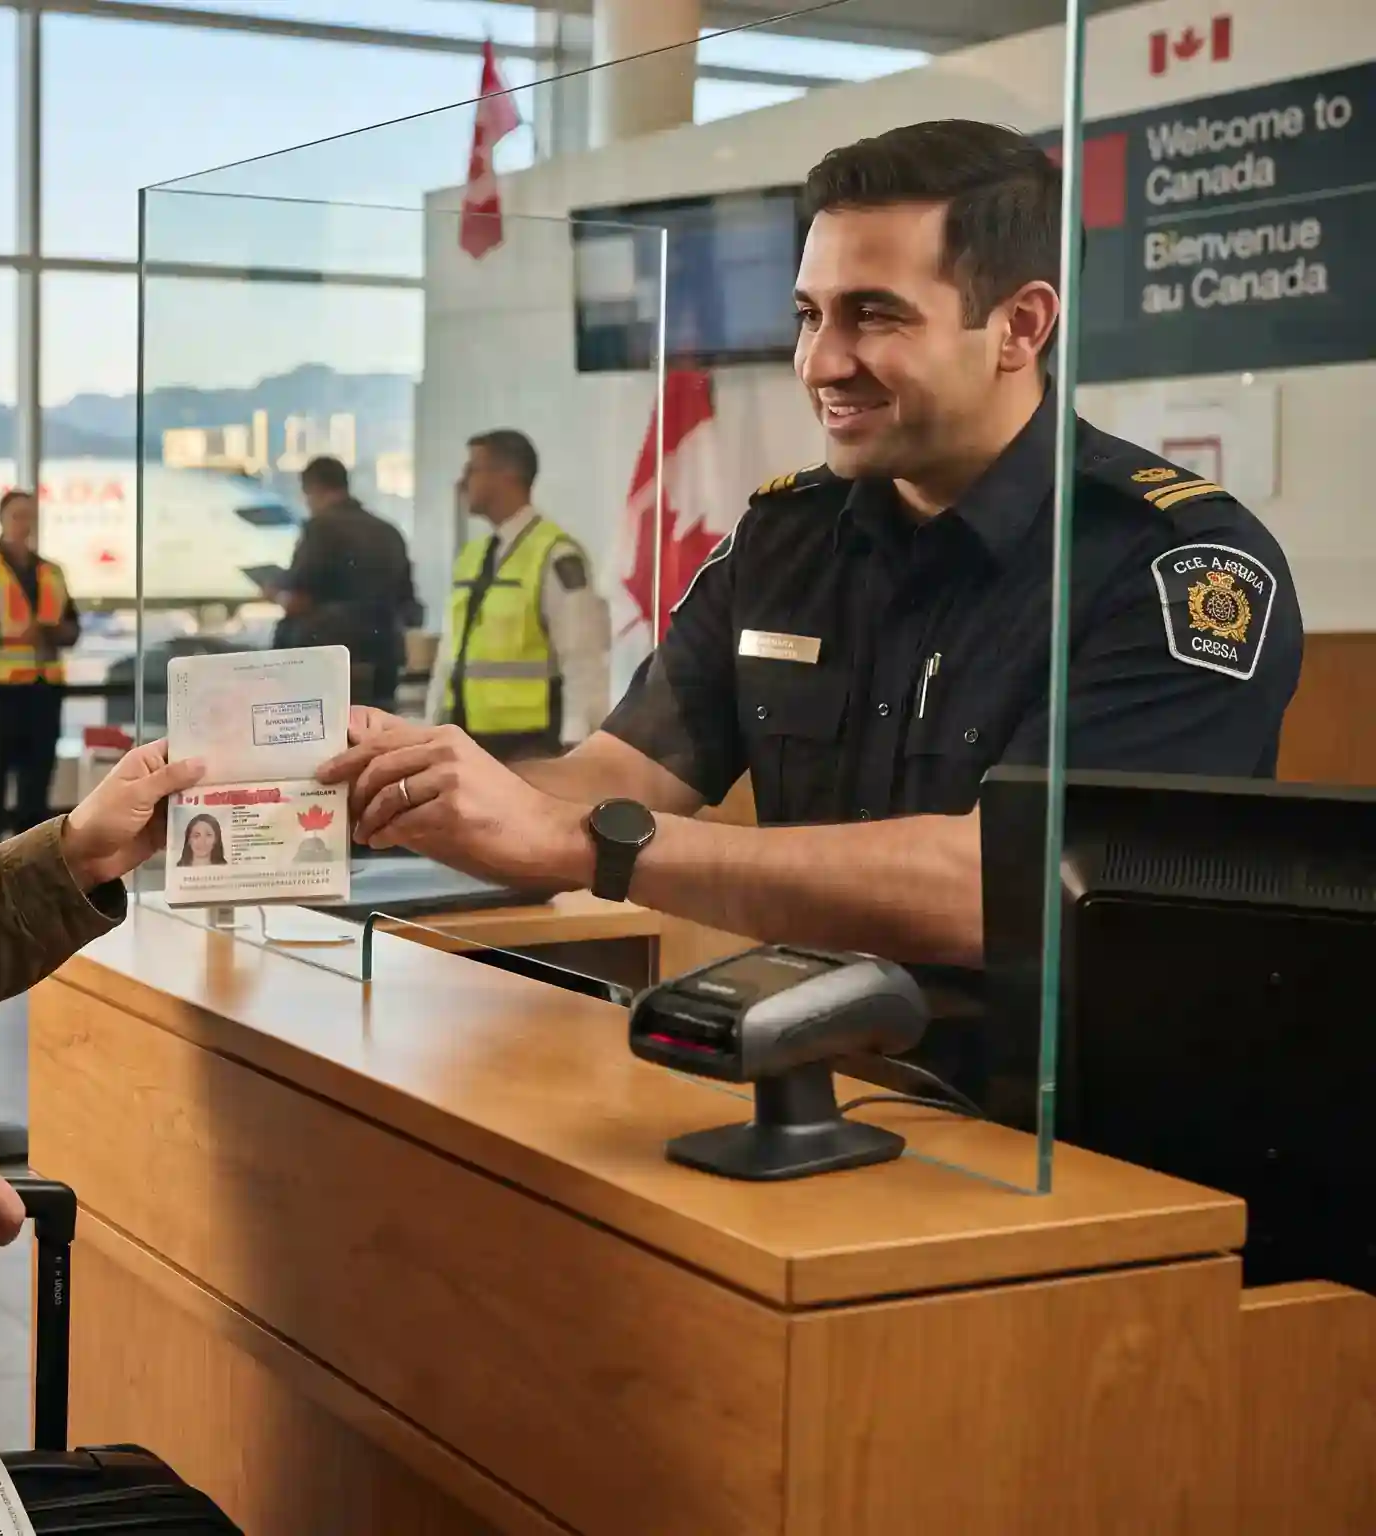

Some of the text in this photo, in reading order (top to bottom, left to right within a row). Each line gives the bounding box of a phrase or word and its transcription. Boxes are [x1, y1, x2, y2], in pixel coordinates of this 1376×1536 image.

[1146, 94, 1352, 161] Welcome to
[1145, 153, 1275, 205] Canada
[1144, 217, 1321, 270] Bienvenue
[1142, 258, 1328, 313] au Canada
